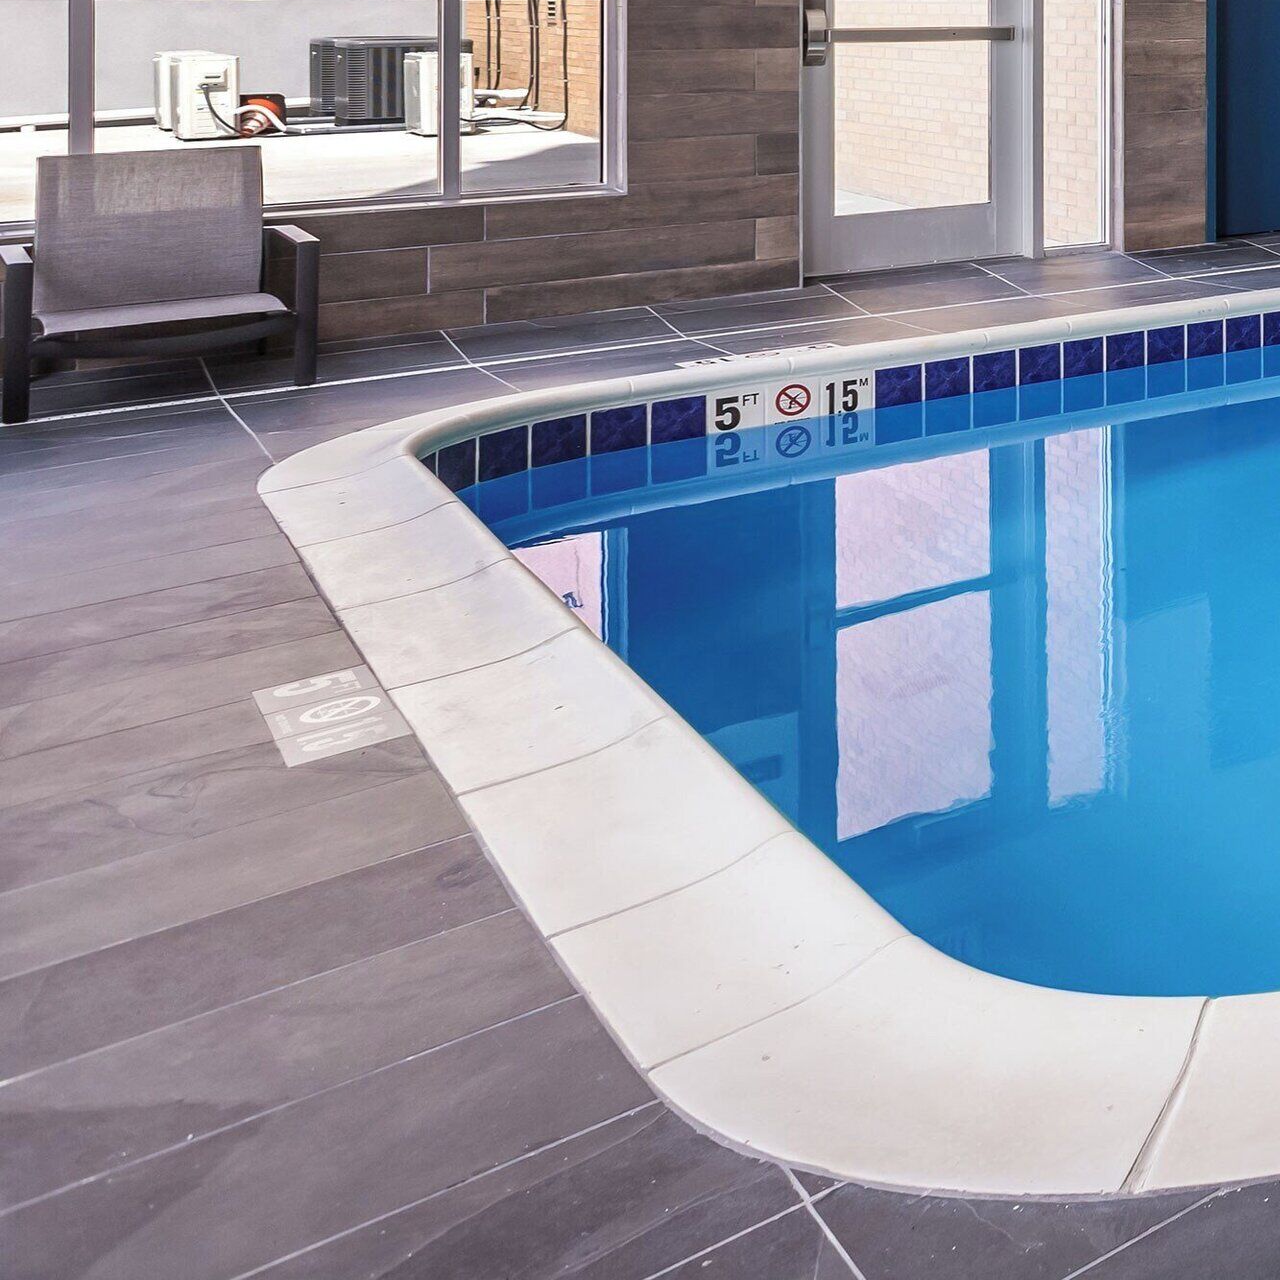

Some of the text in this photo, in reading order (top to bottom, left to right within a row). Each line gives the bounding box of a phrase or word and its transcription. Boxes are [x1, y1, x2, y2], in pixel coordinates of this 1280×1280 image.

[715, 395, 741, 431] 5
[742, 392, 760, 406] FT
[859, 377, 869, 387] M
